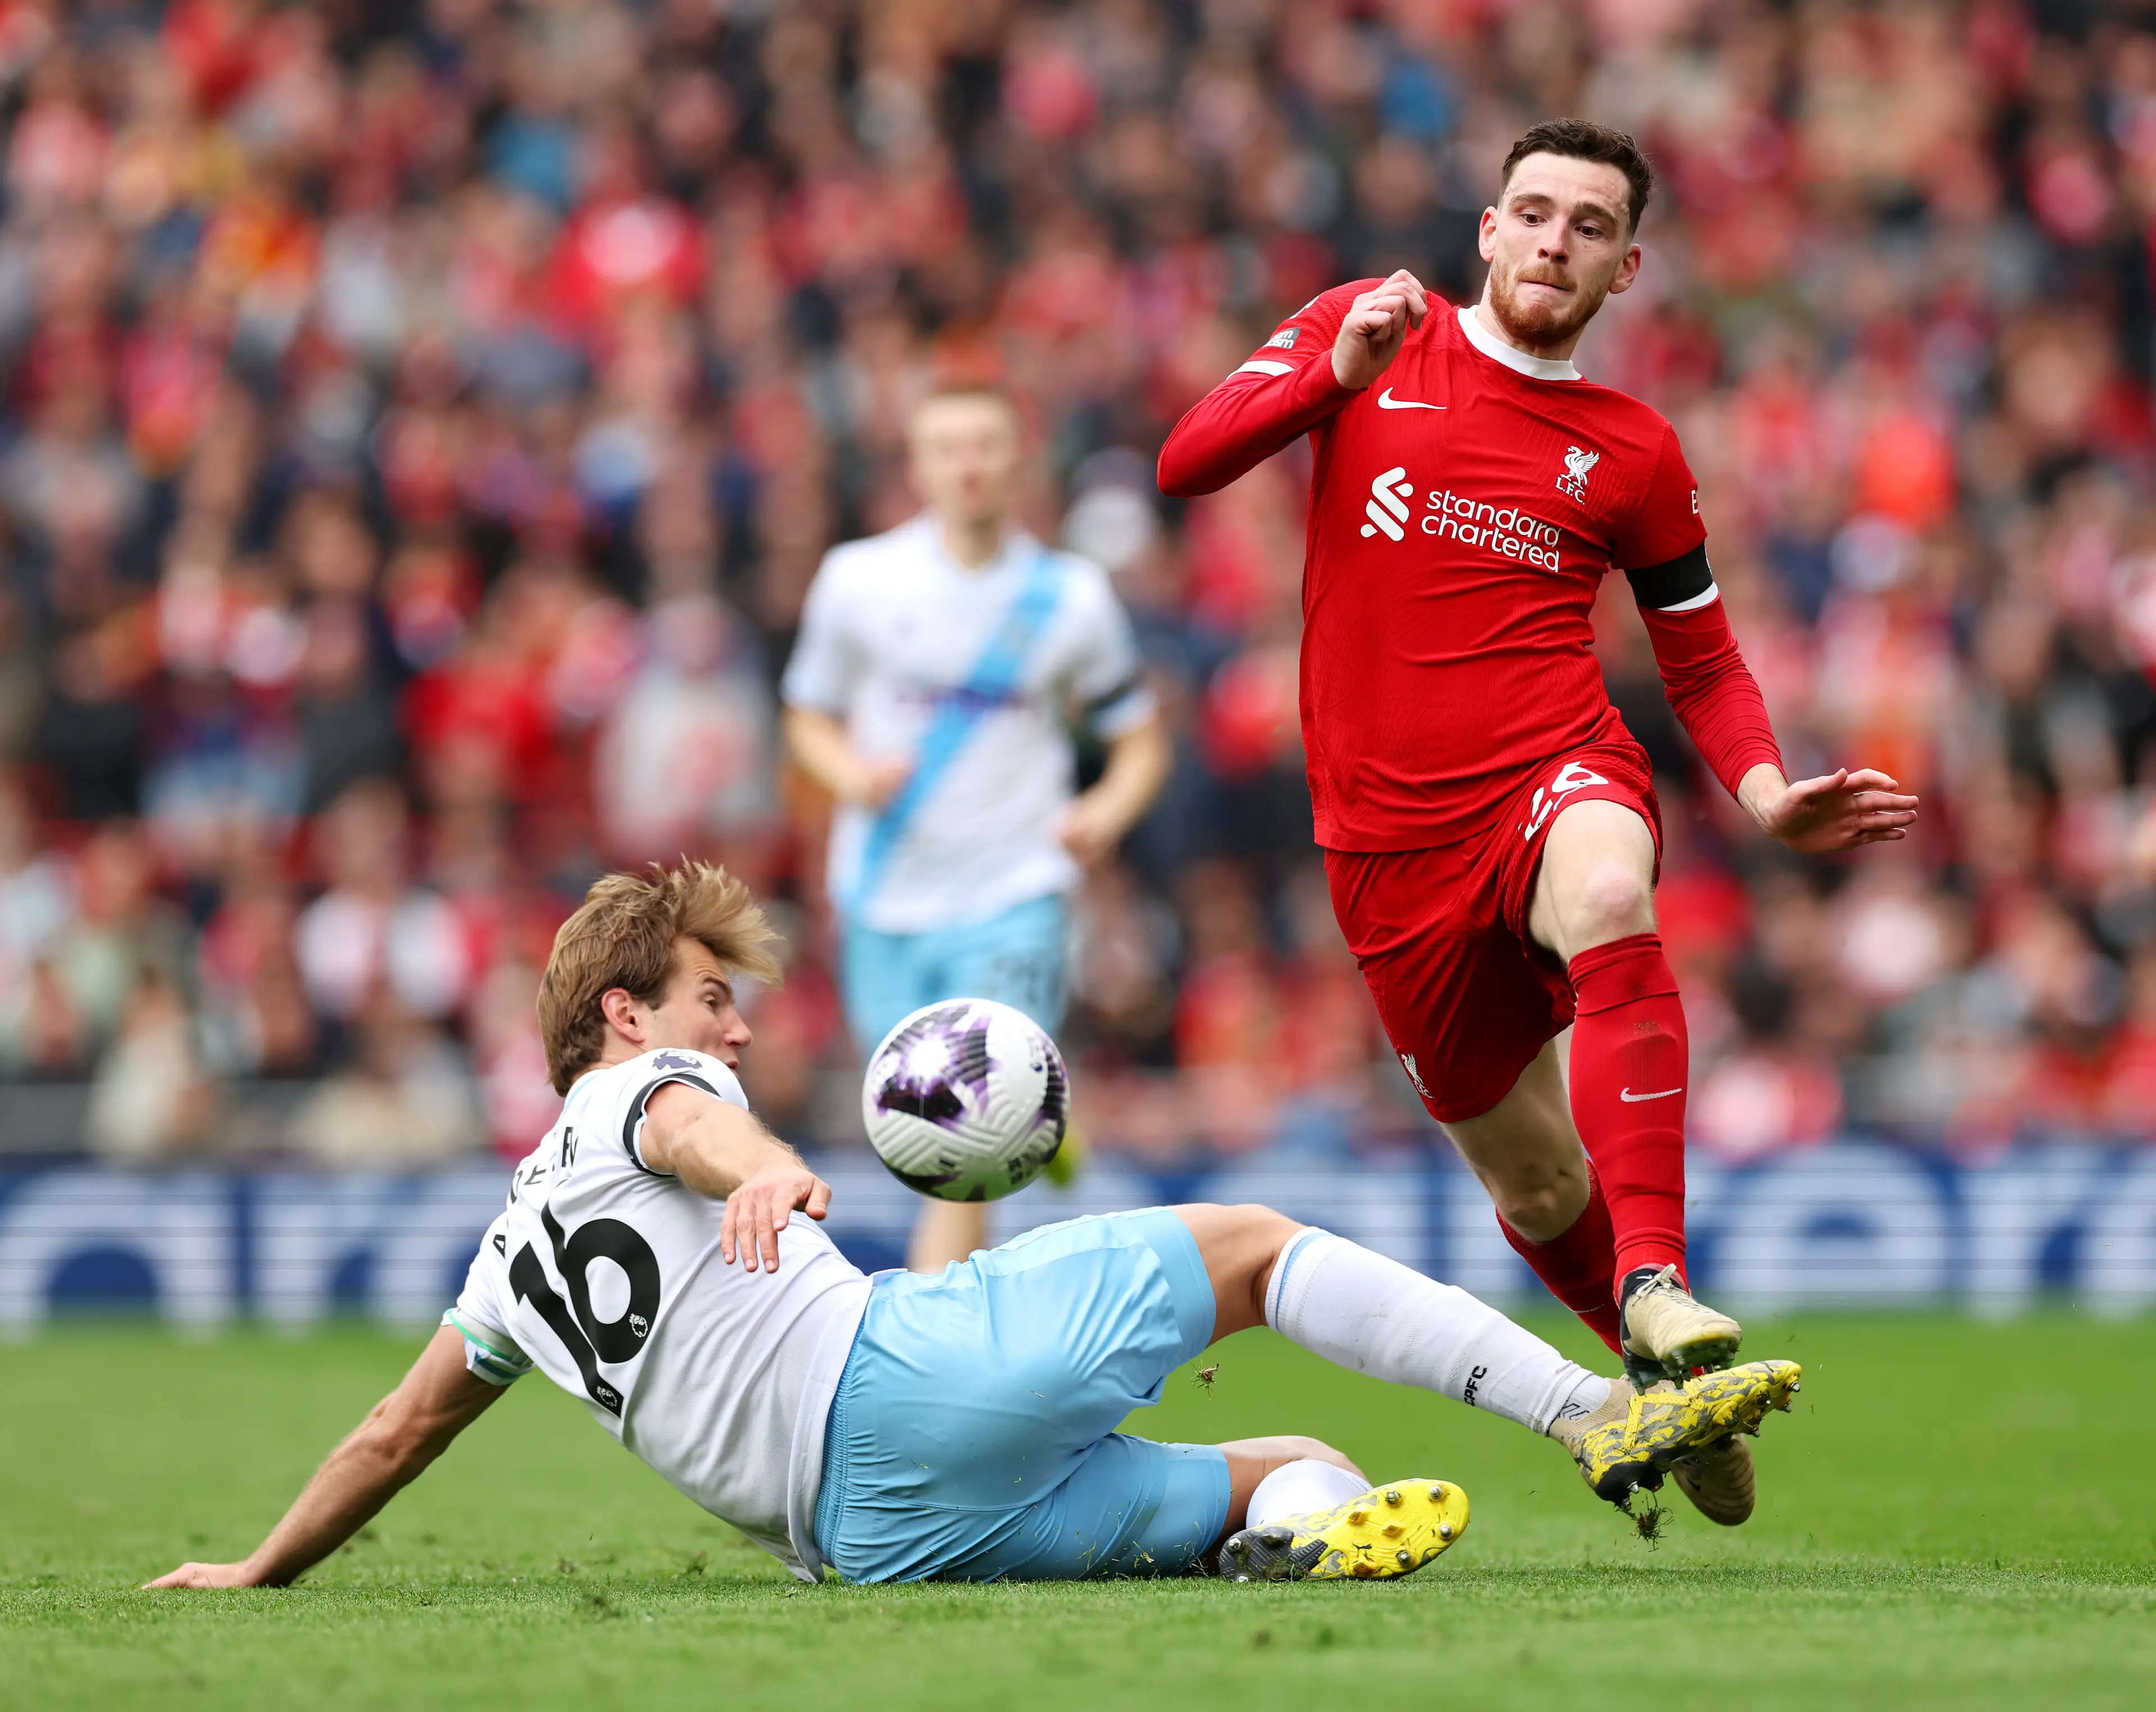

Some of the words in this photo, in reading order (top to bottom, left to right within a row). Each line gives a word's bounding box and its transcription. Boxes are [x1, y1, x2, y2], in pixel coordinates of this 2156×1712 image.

[1421, 513, 1560, 573] chartered
[1426, 490, 1563, 547] standard
[509, 1198, 661, 1419] 16
[1464, 1366, 1487, 1407] CPFC
